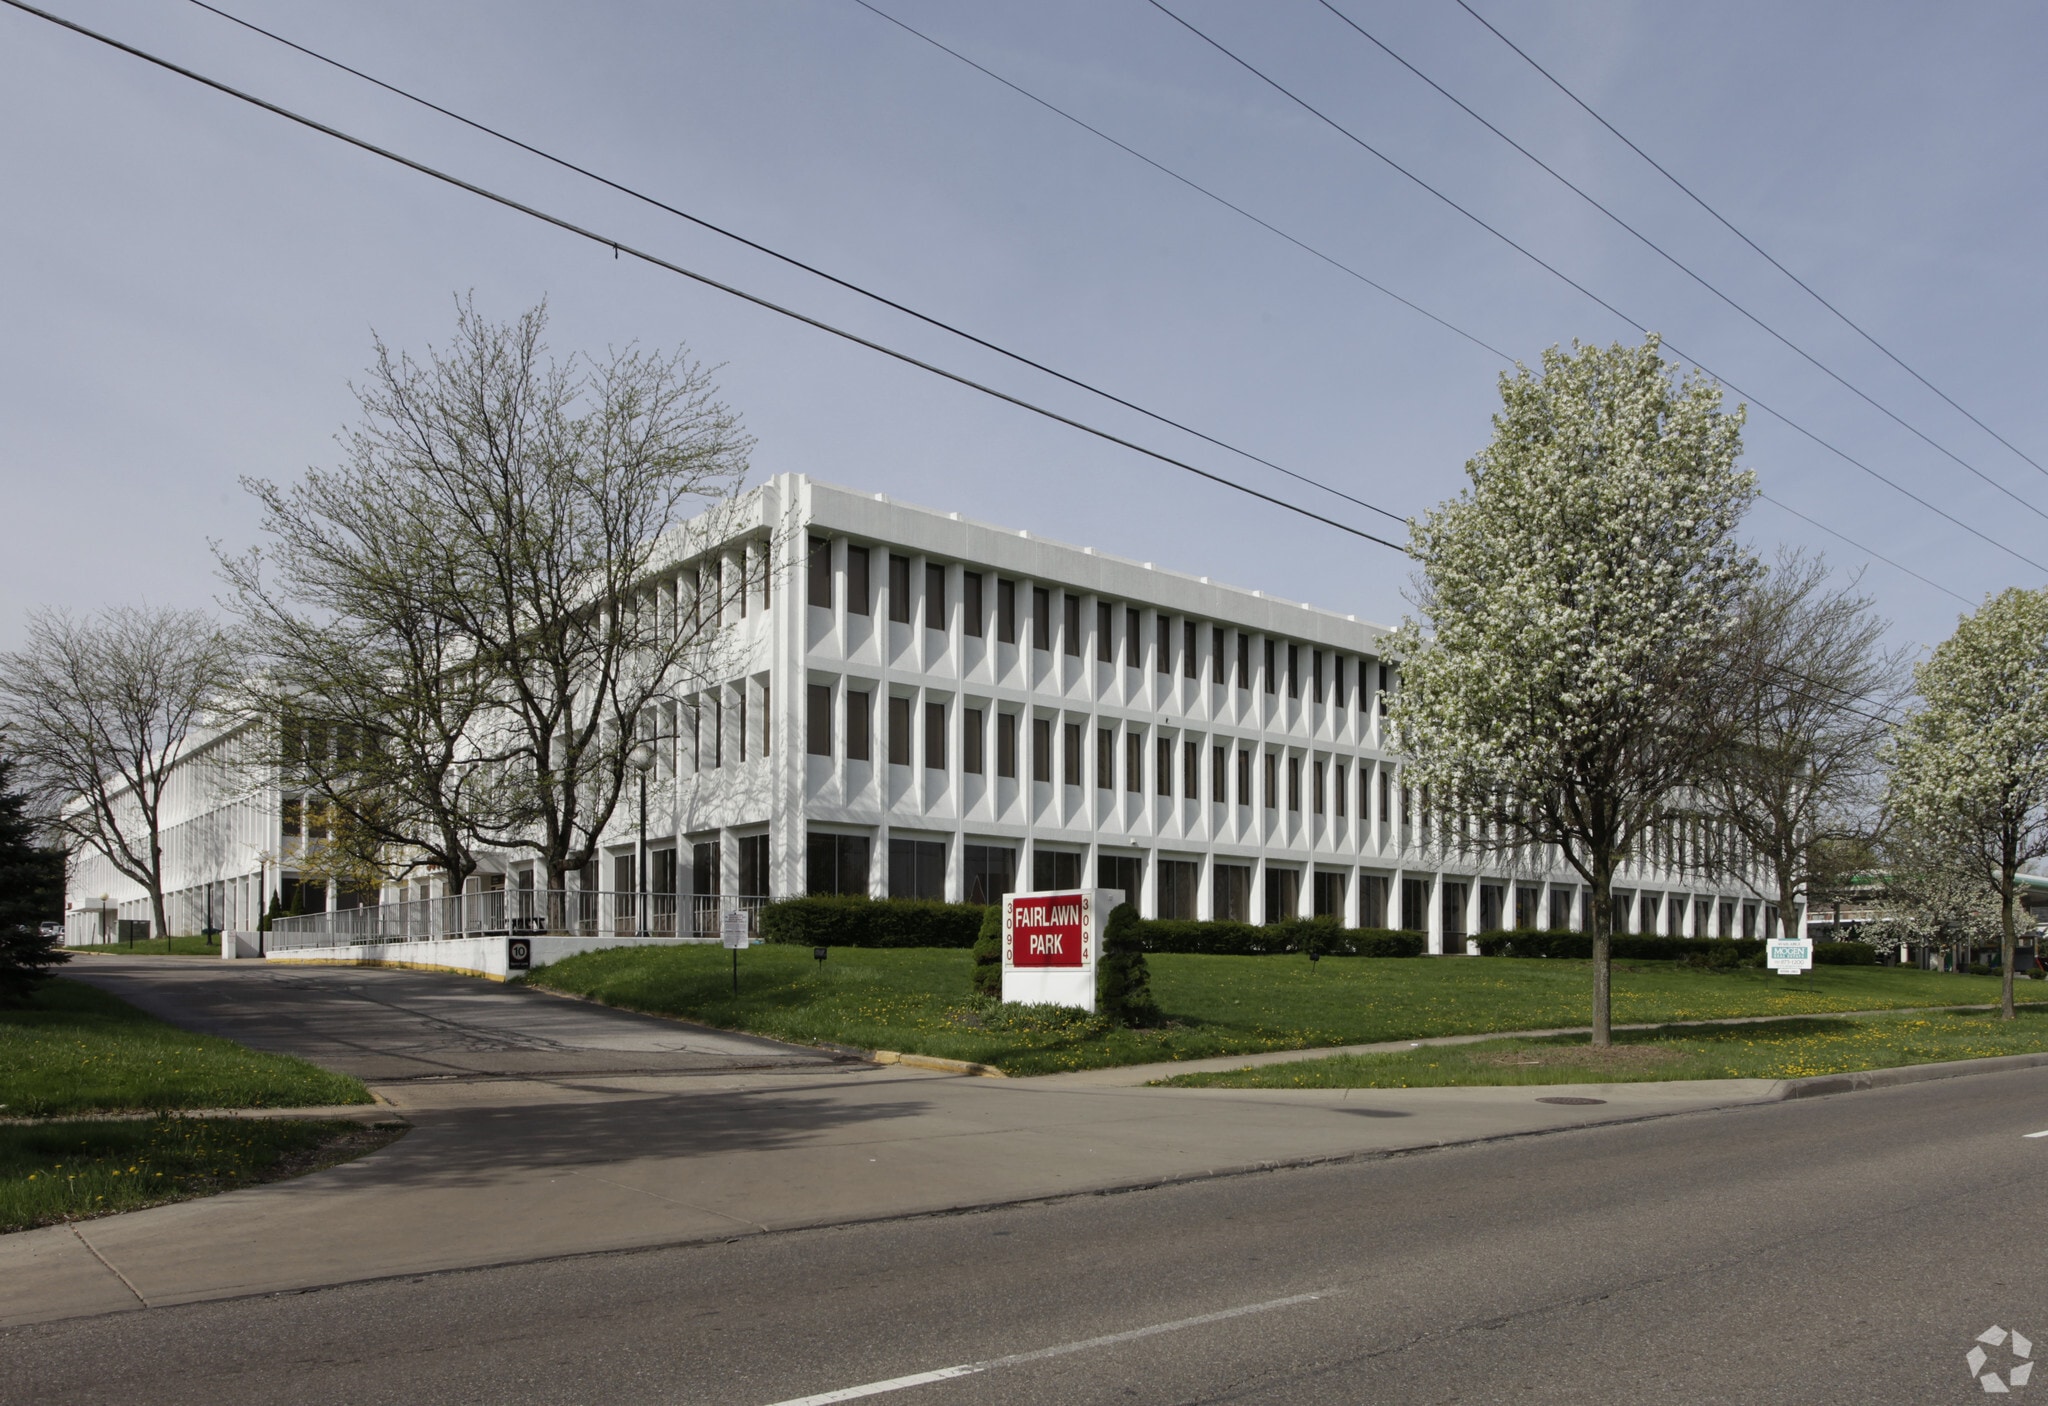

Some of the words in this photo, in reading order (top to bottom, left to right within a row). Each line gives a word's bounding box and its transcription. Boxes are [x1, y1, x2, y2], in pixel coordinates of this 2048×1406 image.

[1015, 905, 1079, 927] FAIRLAWN
[513, 946, 525, 957] 10
[1030, 934, 1063, 954] PARK
